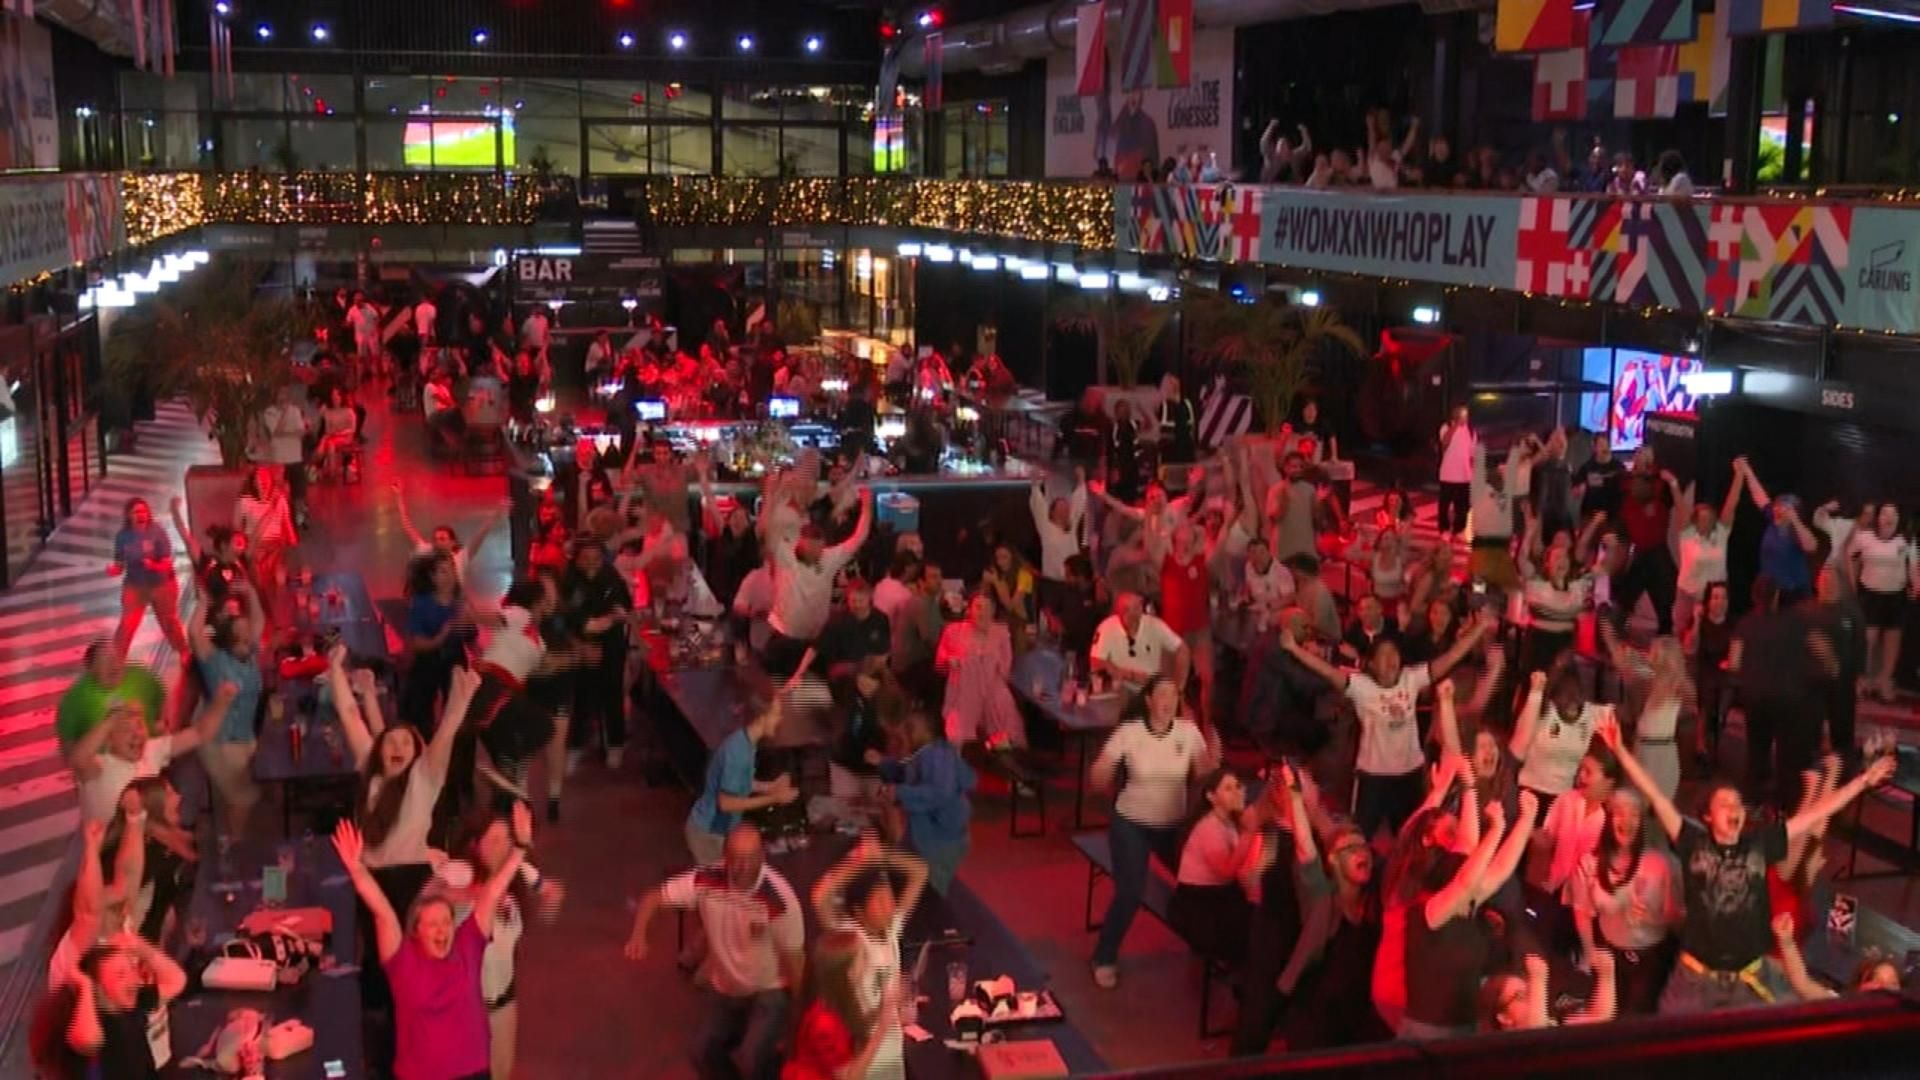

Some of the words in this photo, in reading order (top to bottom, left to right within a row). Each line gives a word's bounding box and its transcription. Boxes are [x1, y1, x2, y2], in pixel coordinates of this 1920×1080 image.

[1274, 206, 1496, 268] #WOMXNWHOPLAY
[520, 258, 573, 281] BAR
[1858, 267, 1911, 291] CARLING
